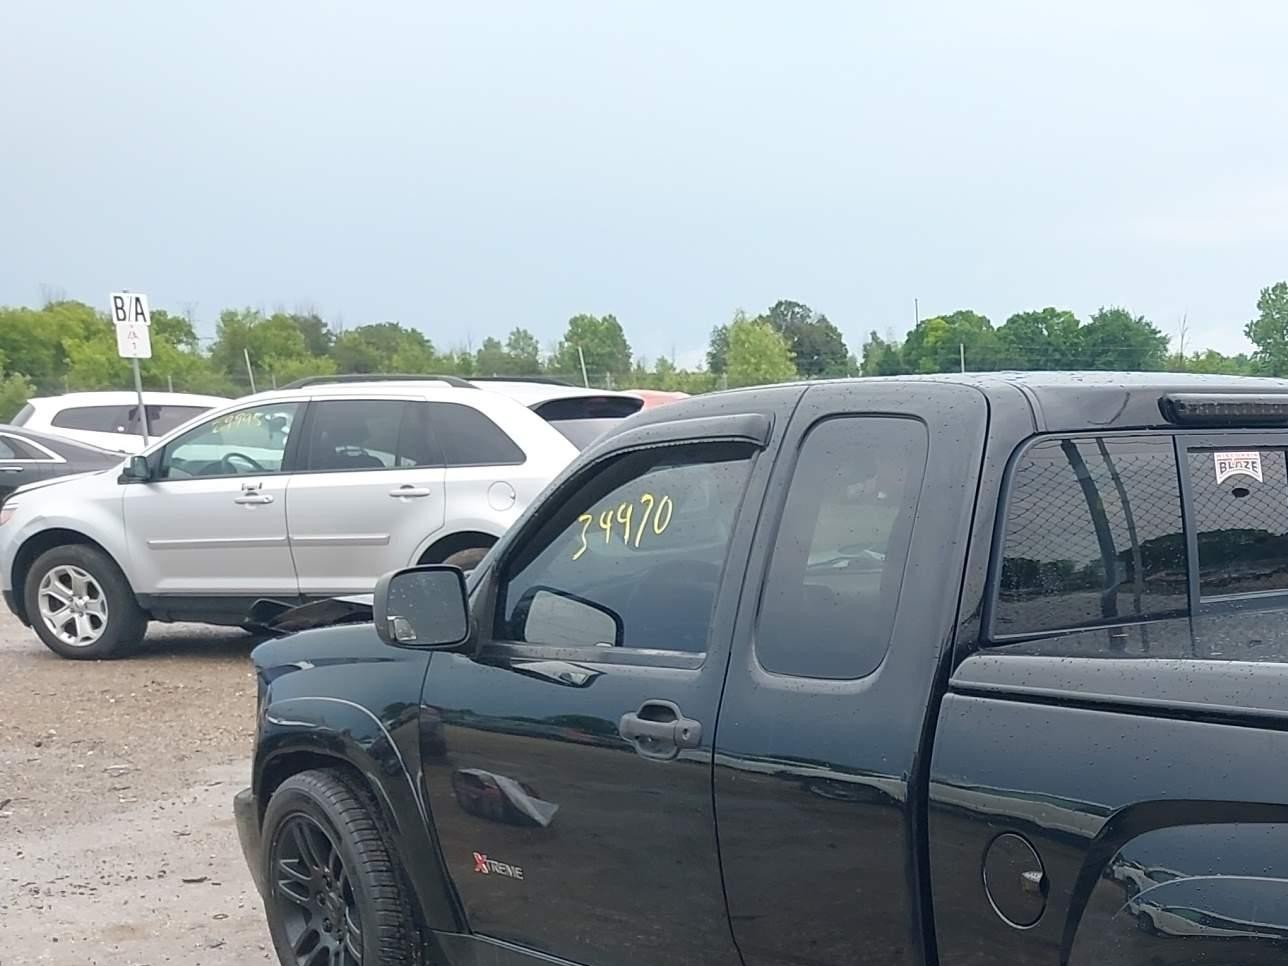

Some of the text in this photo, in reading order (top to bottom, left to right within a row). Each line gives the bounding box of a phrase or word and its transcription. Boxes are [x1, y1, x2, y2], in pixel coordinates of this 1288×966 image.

[113, 296, 147, 322] B/A
[1219, 461, 1259, 474] BLAZE
[472, 852, 524, 880] XTREME
